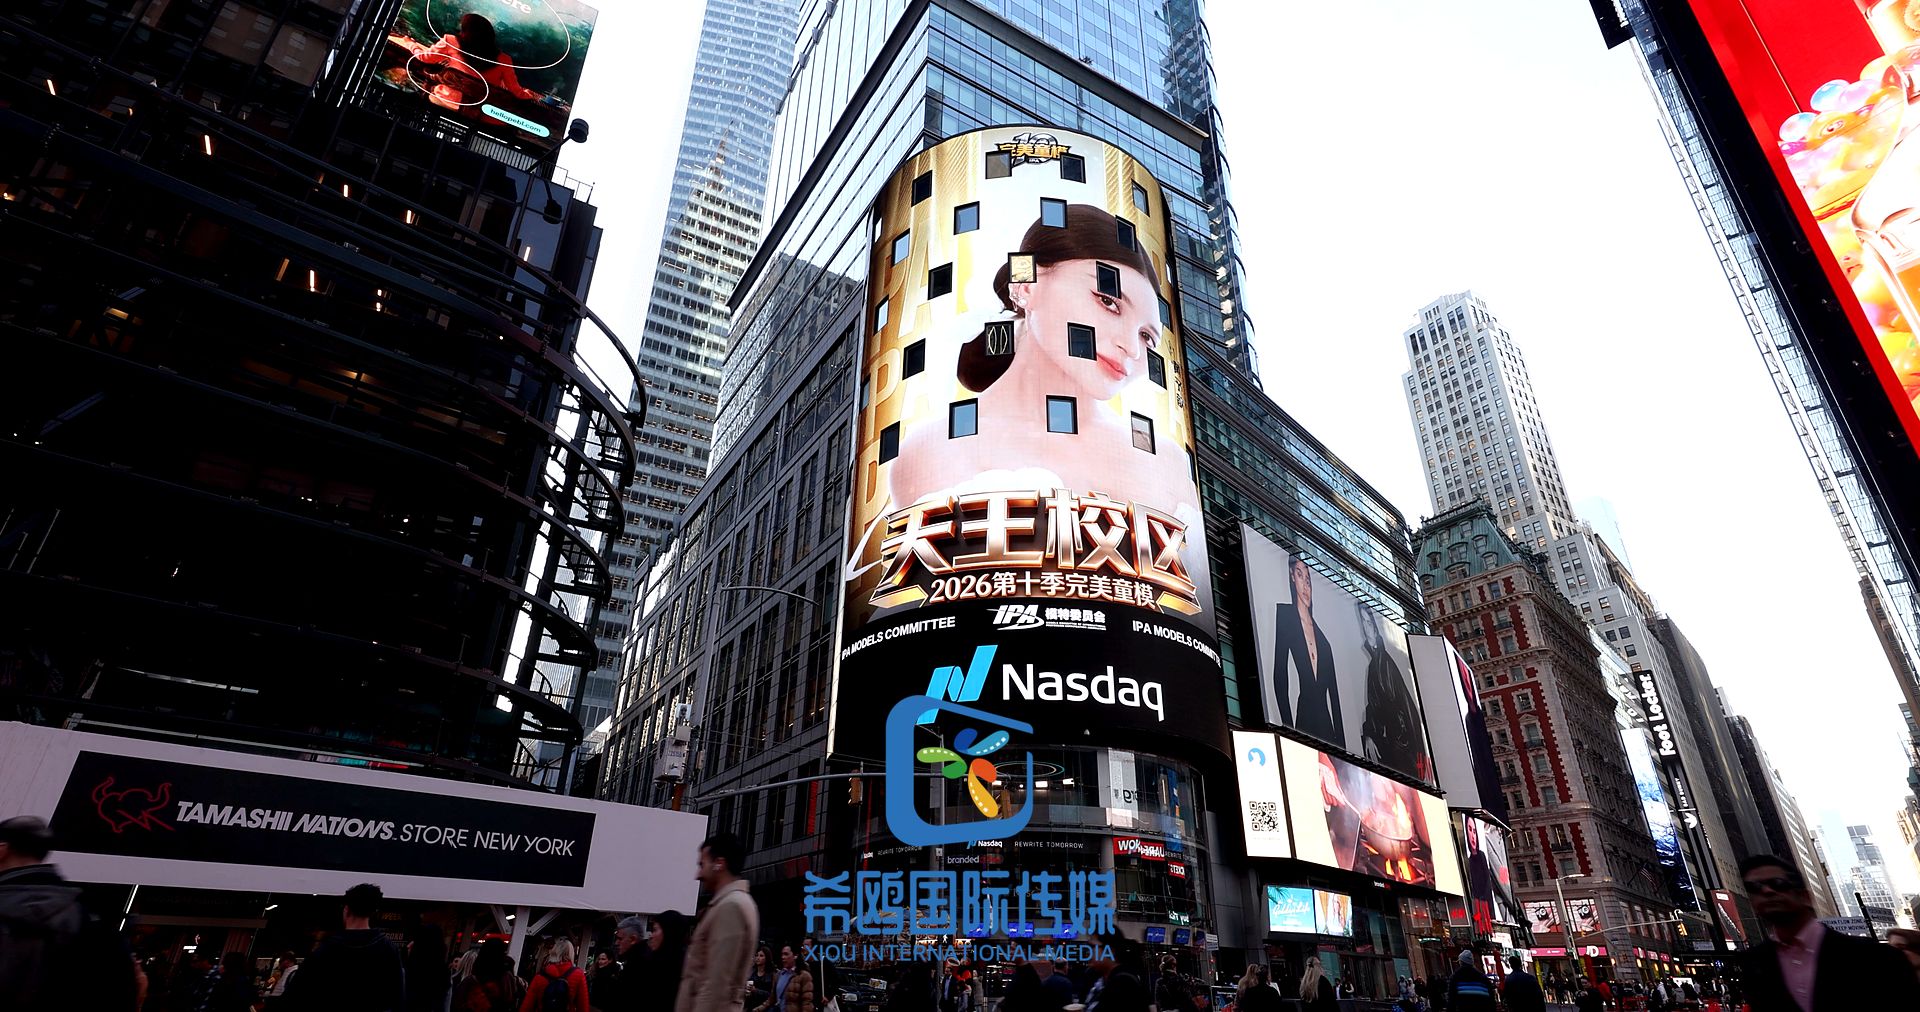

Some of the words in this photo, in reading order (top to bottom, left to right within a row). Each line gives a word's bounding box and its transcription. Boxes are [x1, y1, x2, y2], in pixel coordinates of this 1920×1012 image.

[490, 109, 541, 133] hellopebl.com
[877, 487, 1197, 597] 天王校区
[929, 571, 1156, 608] 2026第十季完美童模
[991, 604, 1042, 627] IPA
[851, 632, 884, 655] MODELS
[885, 615, 956, 640] COMMITTEE
[1132, 619, 1153, 635] IPA
[1153, 624, 1193, 647] MODELS
[1001, 663, 1165, 722] Nasdaq
[1638, 673, 1665, 722] Locker
[1652, 723, 1677, 757] Foot
[176, 800, 294, 832] TAMASHII
[291, 812, 396, 840] NATIONS
[400, 823, 469, 849] STORE
[473, 830, 521, 851] NEW
[523, 835, 576, 857] YORK
[977, 839, 1003, 848] Nasdaq
[1014, 840, 1044, 848] REWRITE
[1047, 841, 1084, 849] TOMORROW
[947, 855, 980, 864] branded
